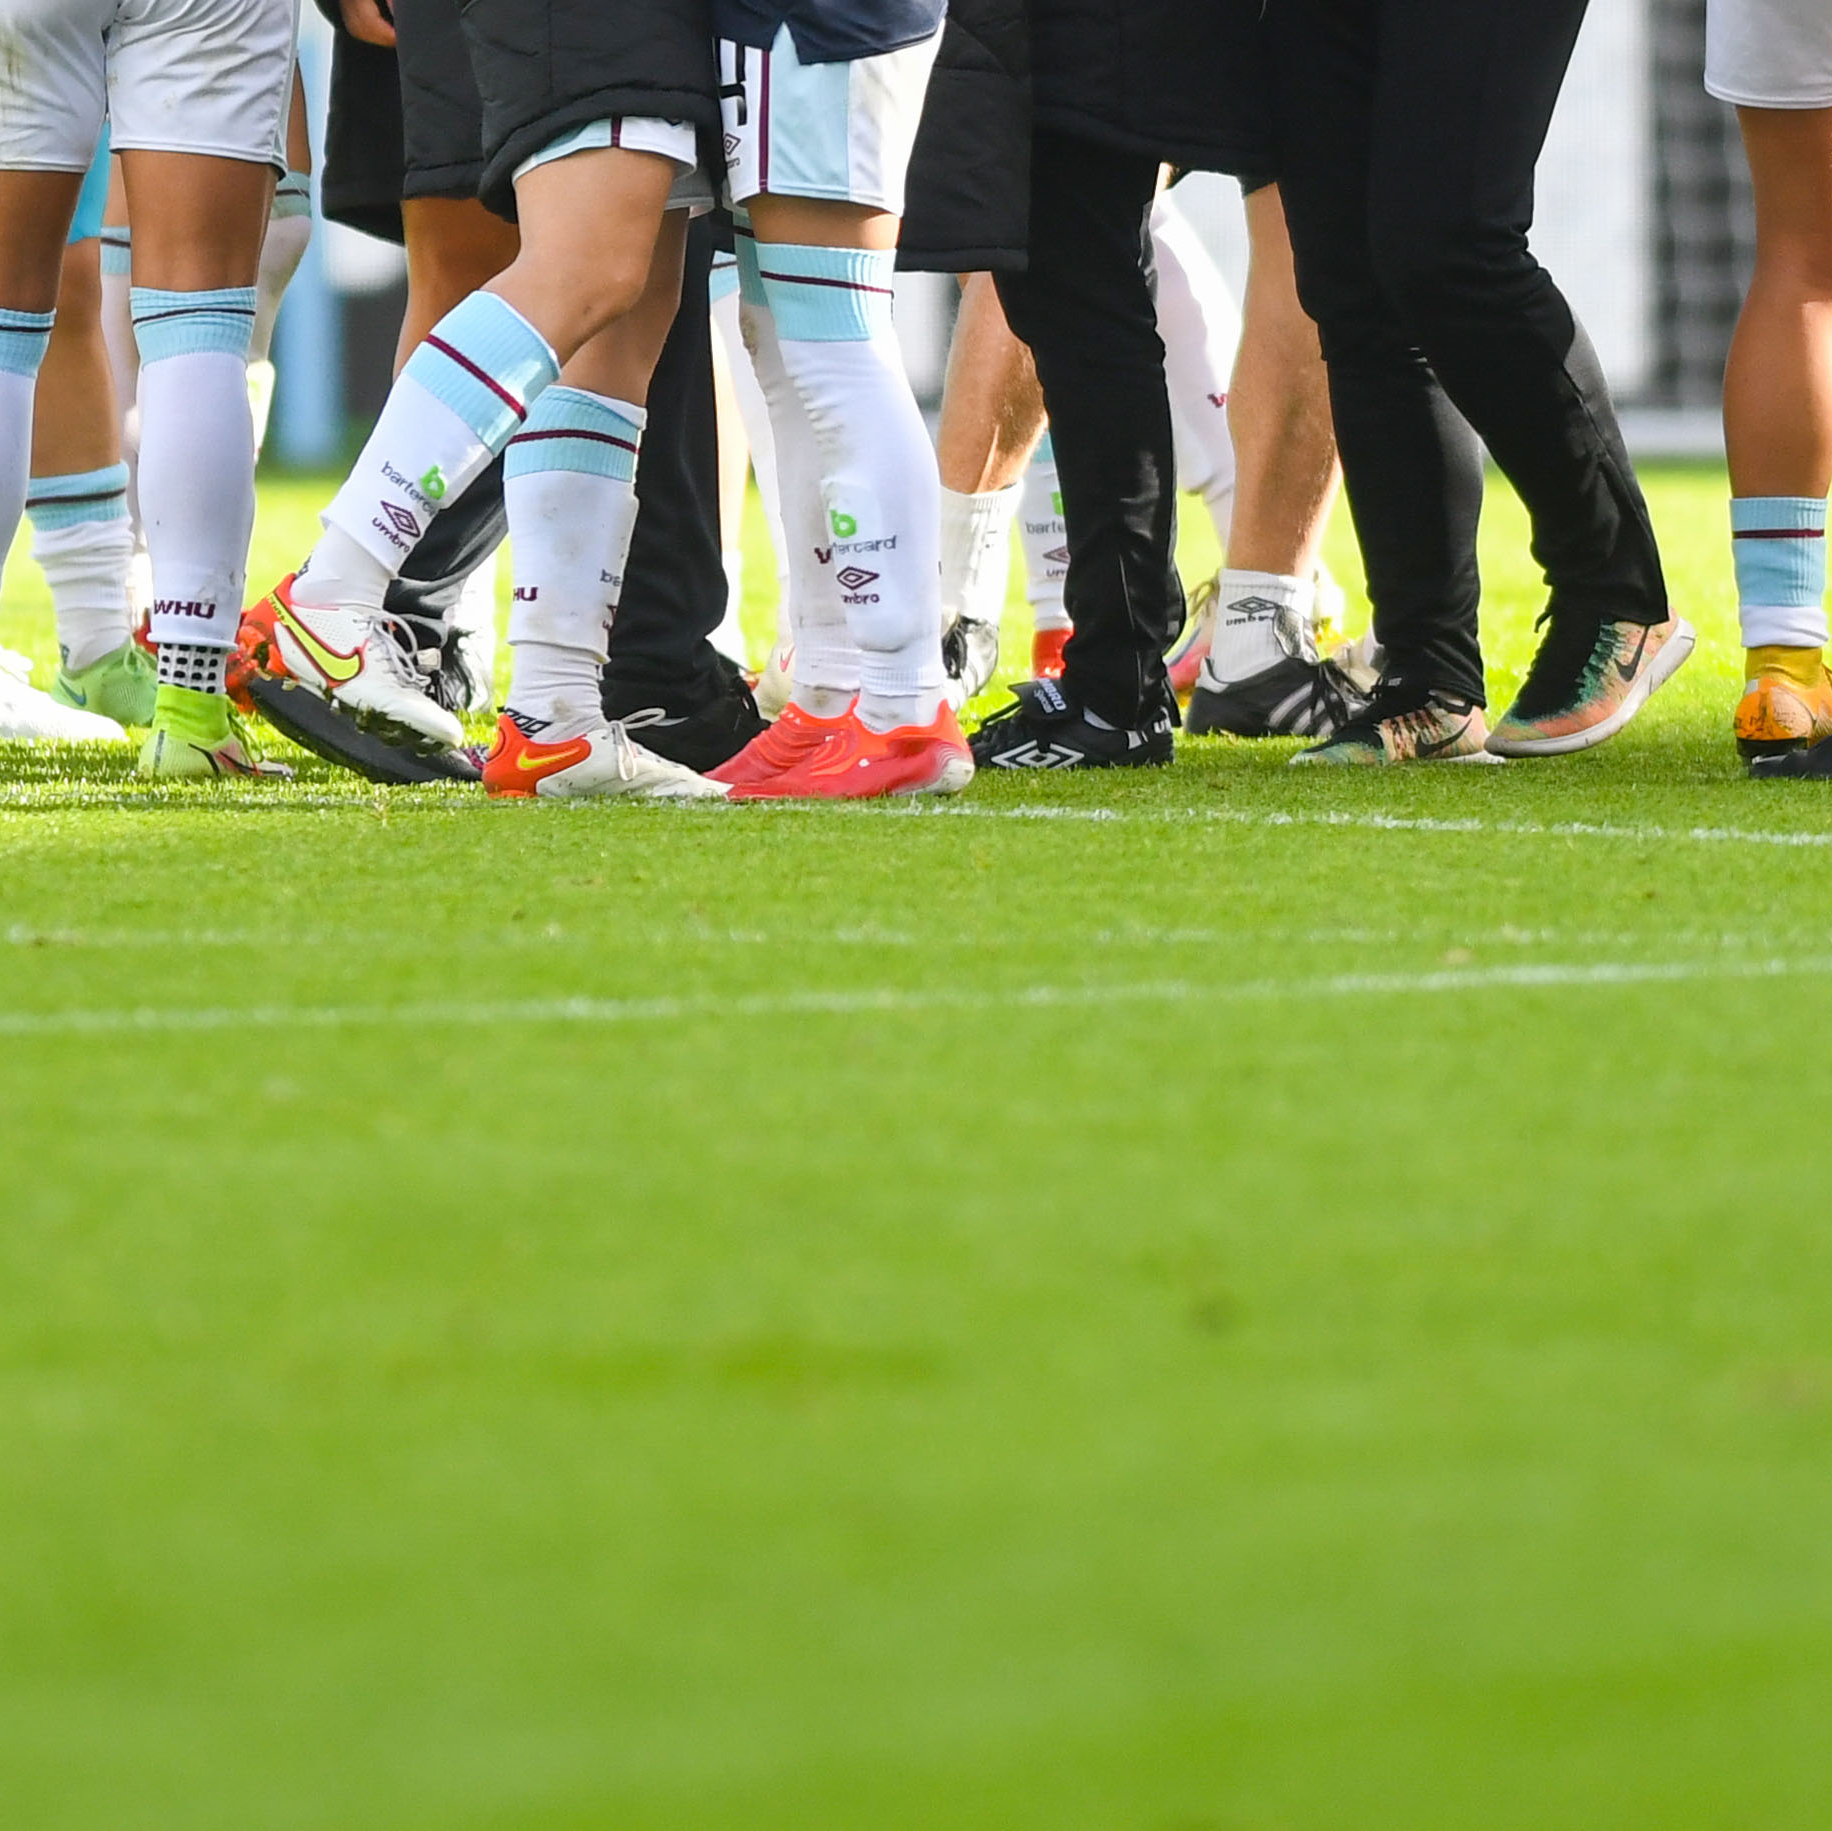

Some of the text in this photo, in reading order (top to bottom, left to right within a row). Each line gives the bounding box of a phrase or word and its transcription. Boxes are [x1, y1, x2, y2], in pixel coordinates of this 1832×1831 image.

[371, 517, 411, 553] umbro
[1025, 521, 1065, 535] barte
[513, 586, 539, 602] HU
[154, 600, 216, 619] WHU
